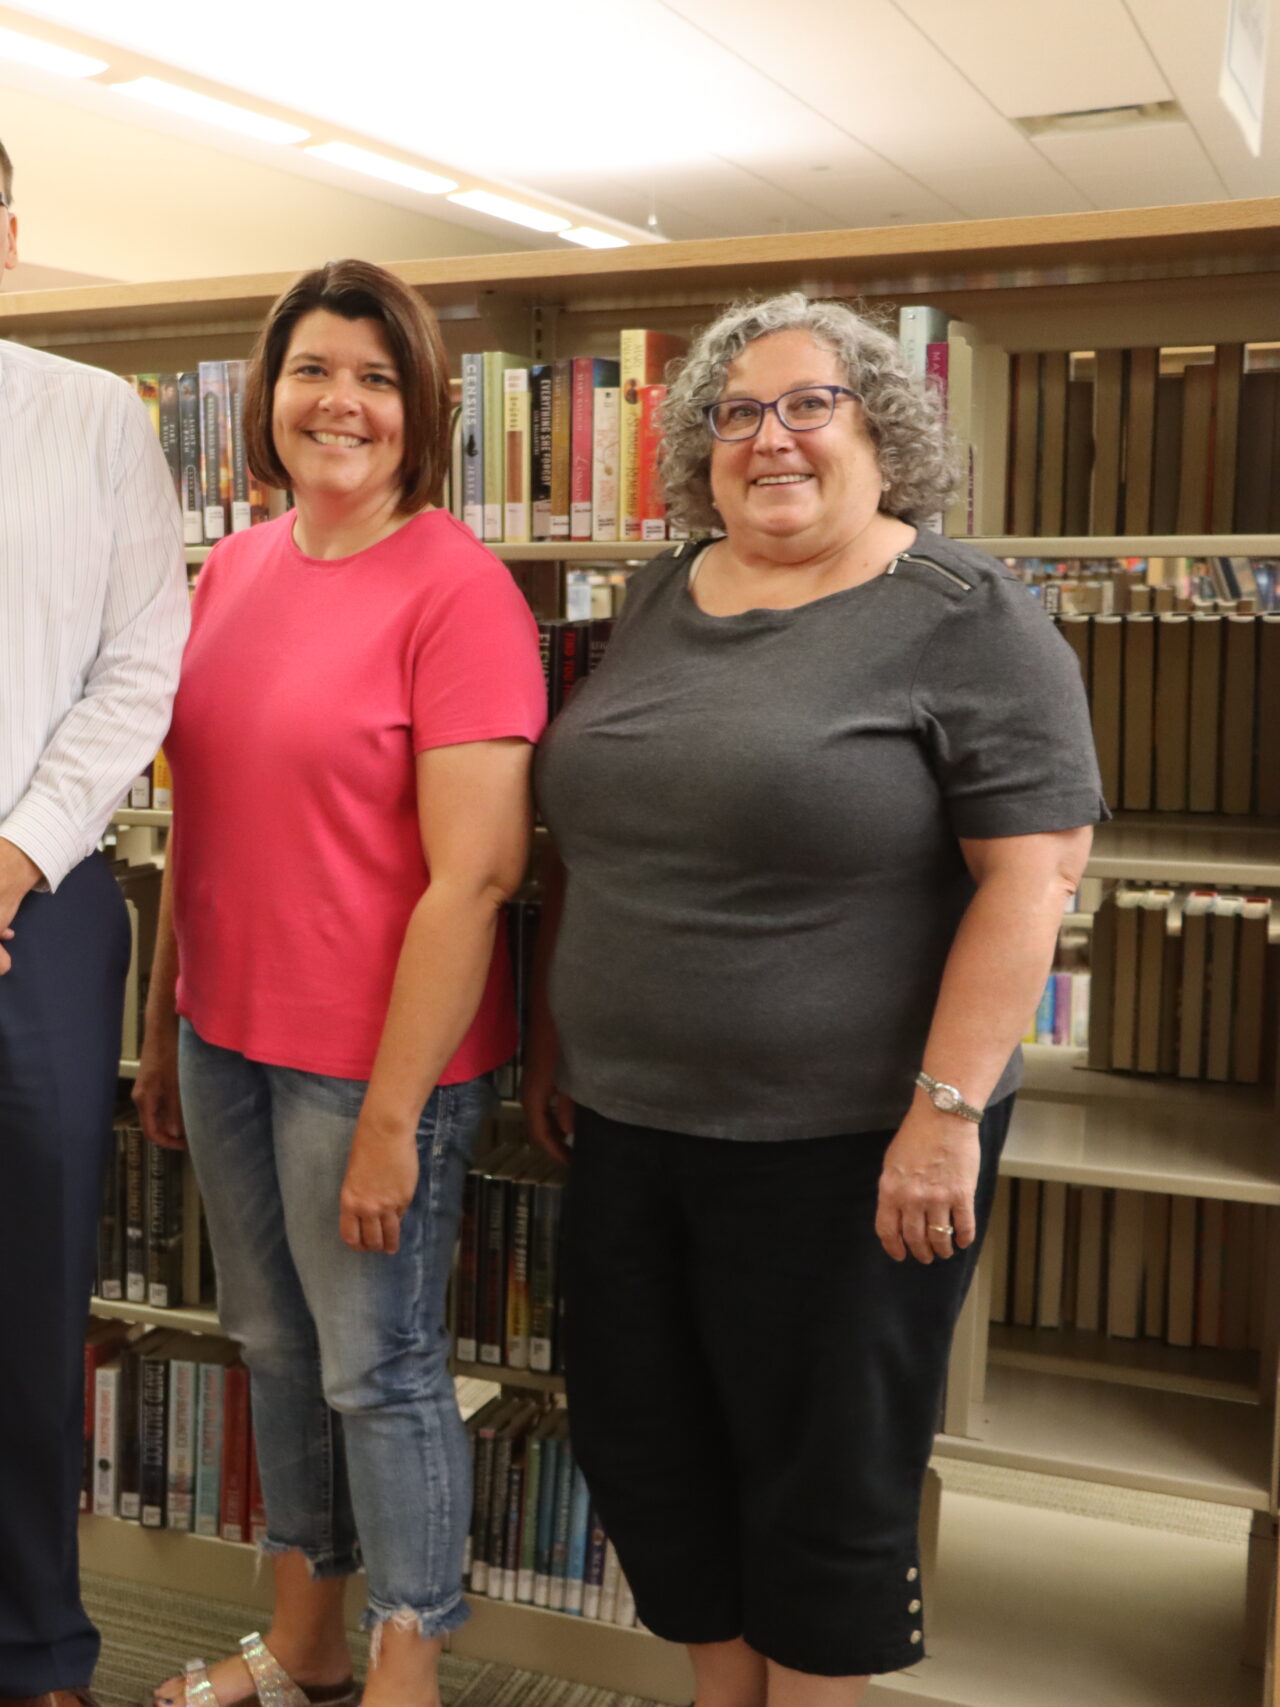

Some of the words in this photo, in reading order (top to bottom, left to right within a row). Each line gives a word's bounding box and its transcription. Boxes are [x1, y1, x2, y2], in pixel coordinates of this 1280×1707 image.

[466, 364, 478, 426] CENSUS
[540, 380, 552, 432] EVERYTHING
[541, 434, 552, 451] SHE
[542, 452, 552, 486] FORGOT
[562, 632, 576, 656] FIND
[152, 1180, 164, 1234] BALDACCI
[144, 1364, 164, 1402] DAVID
[144, 1406, 164, 1466] BALDACCI
